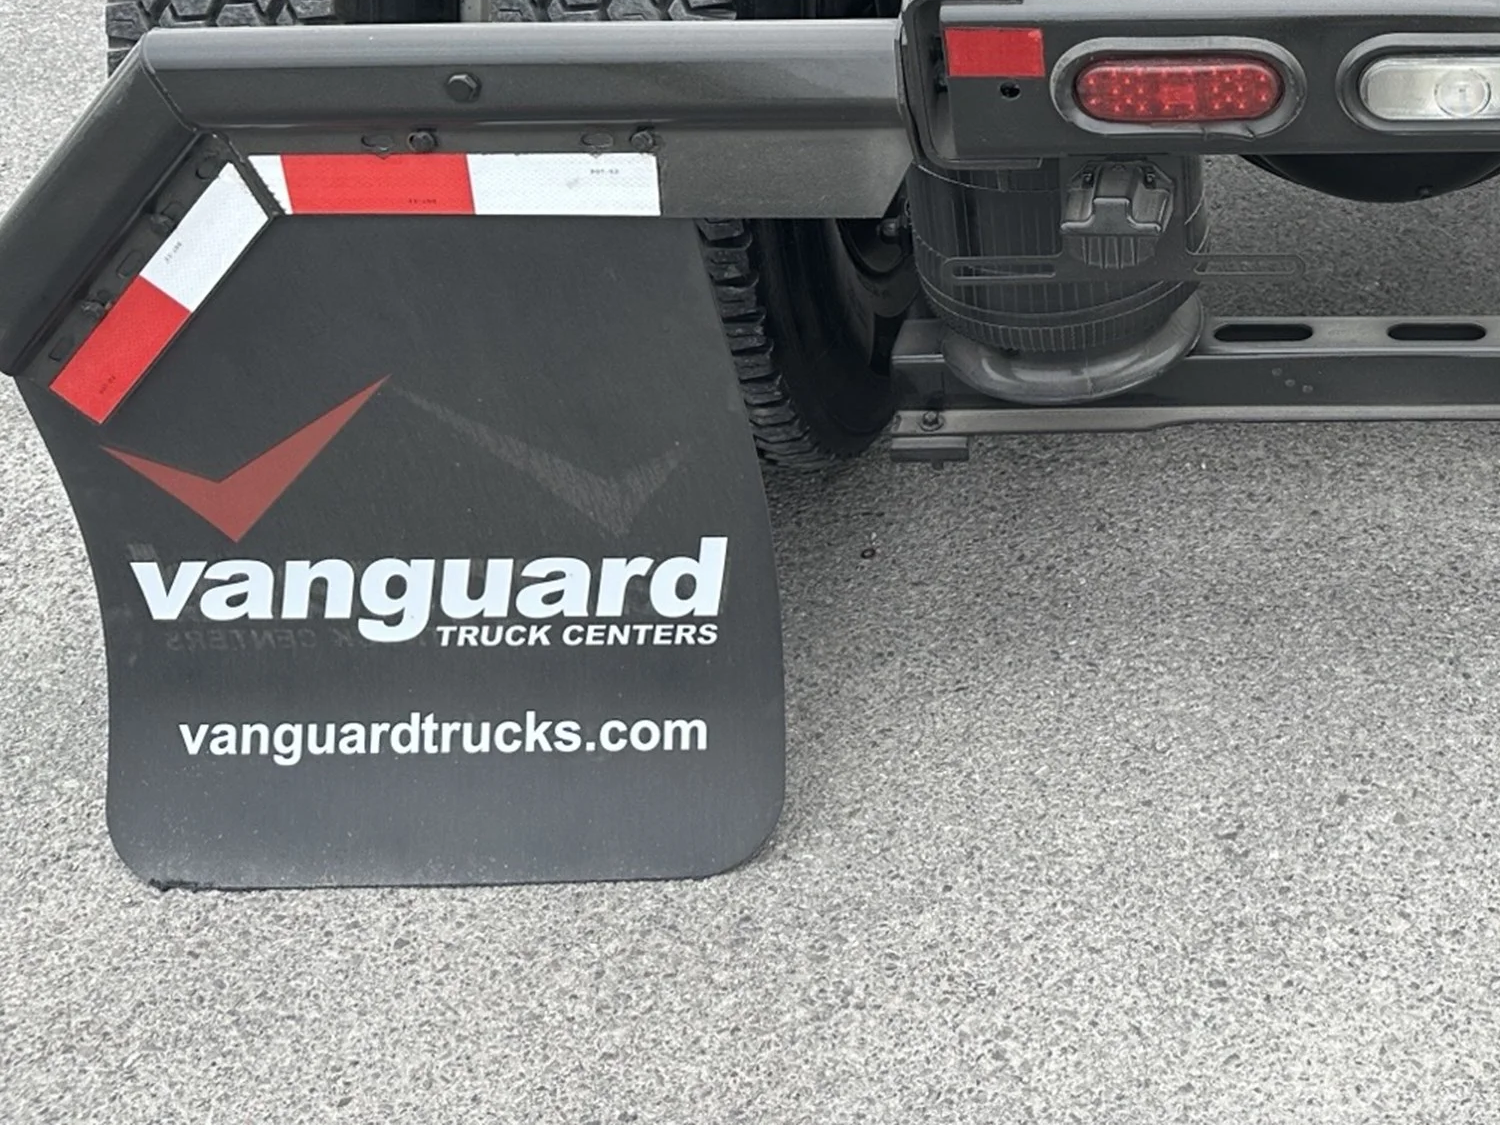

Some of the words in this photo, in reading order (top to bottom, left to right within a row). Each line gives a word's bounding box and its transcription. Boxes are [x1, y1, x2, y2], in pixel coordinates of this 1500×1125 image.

[129, 536, 729, 644] vanguard
[436, 624, 552, 647] TRUCK
[562, 623, 719, 646] CENTERS
[178, 710, 708, 767] vanguardtrucks.com
